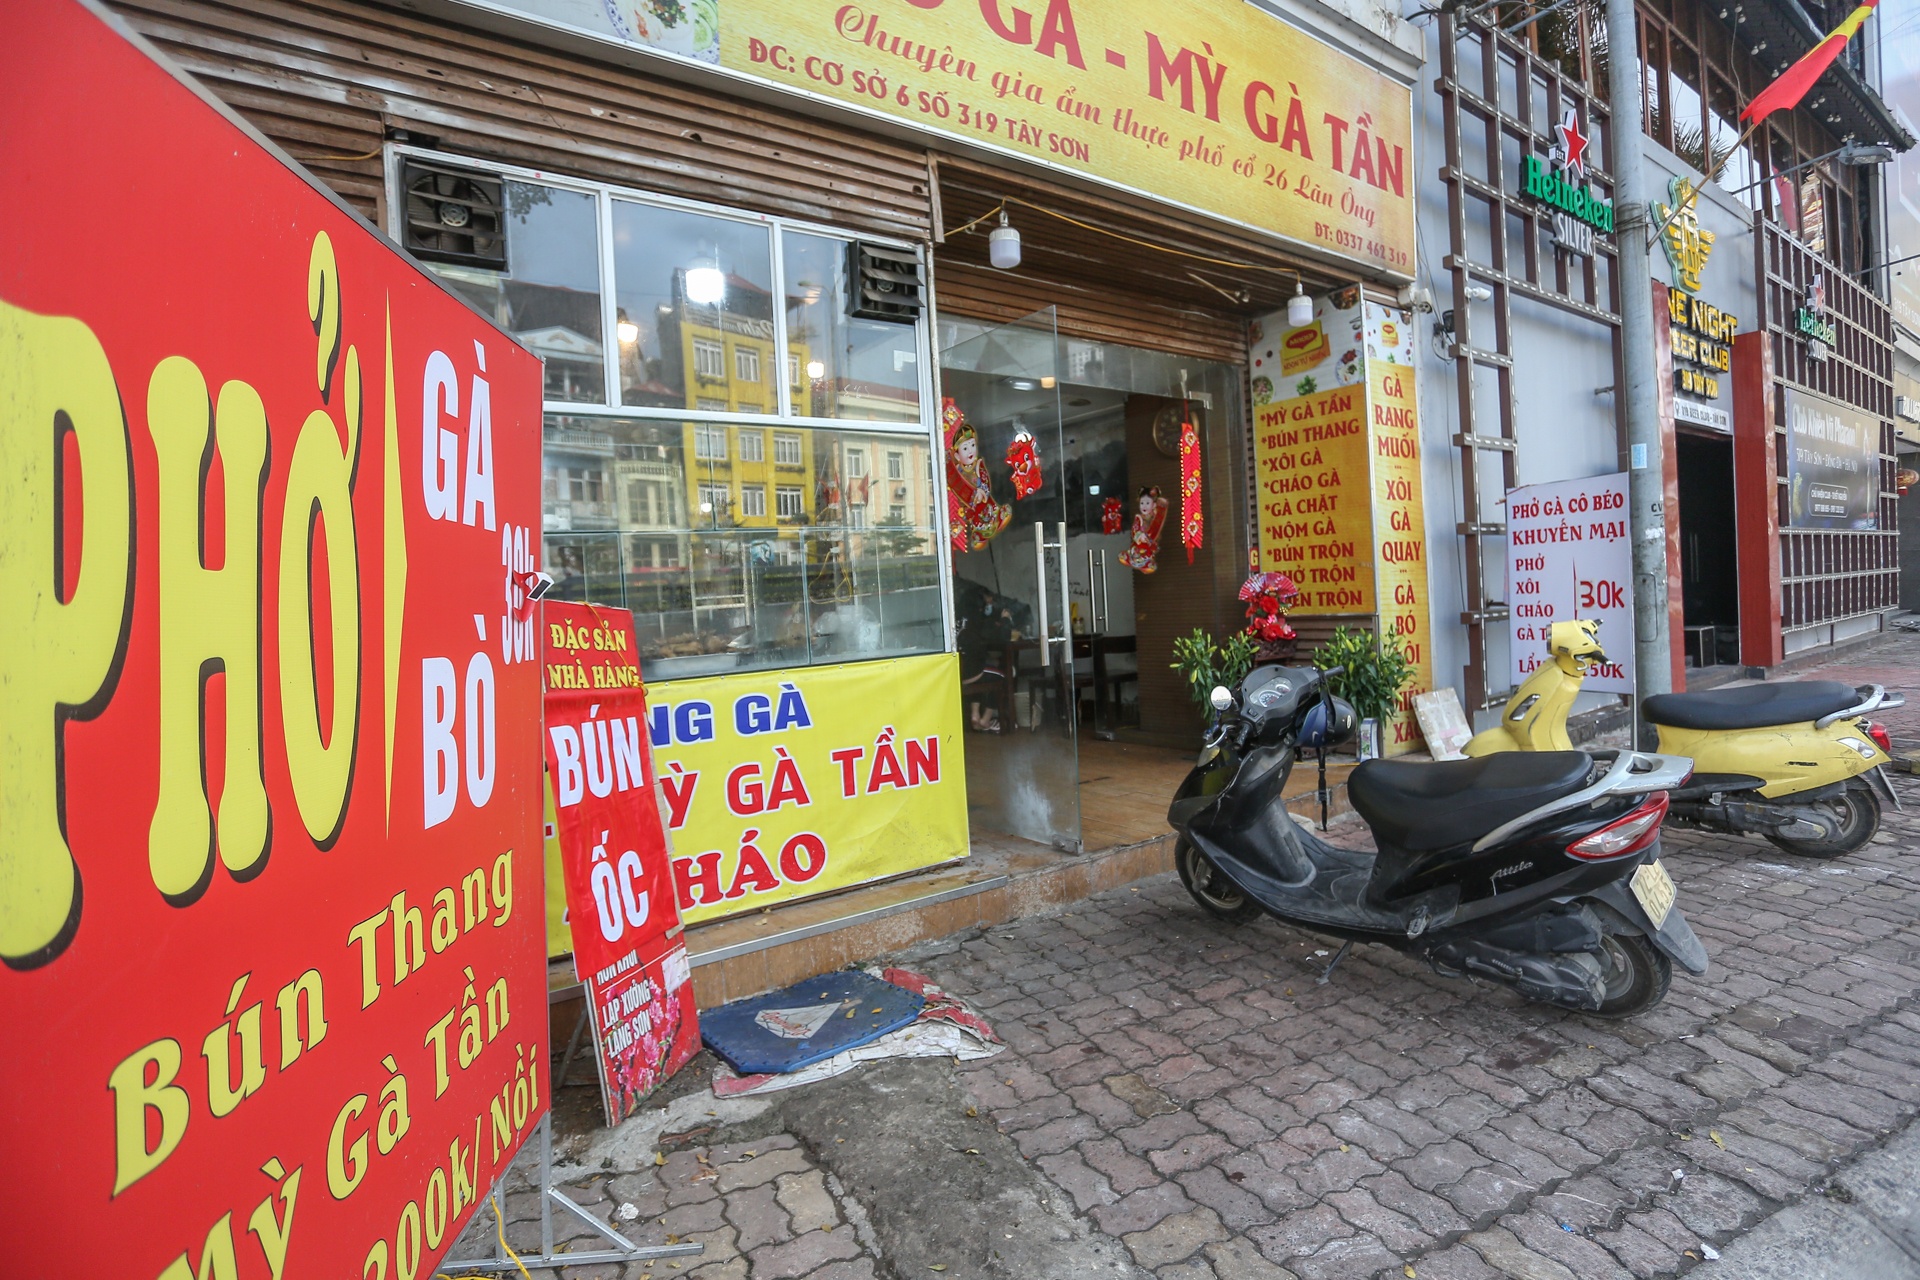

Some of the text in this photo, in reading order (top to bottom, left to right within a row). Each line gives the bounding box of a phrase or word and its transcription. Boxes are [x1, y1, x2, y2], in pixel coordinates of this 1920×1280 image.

[747, 36, 1090, 163] ĐC: CƠ SỞ 6 SỐ 319 TÂY SƠN
[834, 5, 979, 82] Chuyên
[991, 71, 1045, 105] gia
[1056, 86, 1103, 125] ẩm
[1112, 107, 1170, 149] thực
[1178, 135, 1227, 167] phố
[1232, 154, 1257, 179] cổ
[1263, 163, 1288, 191] 26
[1340, 187, 1376, 228] Ông
[1144, 30, 1228, 123] MỲ
[1243, 81, 1314, 161] GÀ
[1323, 110, 1405, 199] TẦN
[1525, 154, 1614, 233] Heineken
[1314, 221, 1333, 242] ĐT:
[1336, 228, 1364, 251] 0337
[1389, 247, 1408, 266] 319
[1557, 212, 1593, 256] SILVER
[1691, 298, 1738, 346] NIGHT
[1699, 341, 1729, 372] CLUB
[1382, 373, 1404, 398] GÀ
[1292, 401, 1314, 421] GÀ
[1319, 394, 1352, 416] TẦN
[1375, 404, 1415, 429] RANG
[421, 339, 497, 532] GÀ
[1302, 418, 1360, 443] THANG
[1300, 447, 1323, 467] GÀ
[1377, 432, 1416, 459] MUỐI
[1317, 468, 1341, 487] GÀ
[1385, 476, 1412, 501] XÔI
[1296, 494, 1338, 516] CHẶT
[1512, 489, 1624, 519] PHỞ GÀ CÔ BÉO
[1313, 516, 1336, 535] GÀ
[1390, 506, 1412, 531] GÀ
[1512, 518, 1626, 545] KHUYẾN MẠI
[1310, 541, 1354, 561] TRỘN
[1382, 541, 1421, 564] QUAY
[1515, 553, 1545, 571] PHỞ
[1310, 564, 1355, 585] TRỘN
[1515, 578, 1540, 594] XÔI
[0, 230, 363, 970] PHỞ
[1316, 589, 1363, 608] TRỘN
[1394, 580, 1415, 605] GÀ
[1516, 601, 1554, 617] CHÁO
[549, 618, 627, 656] ĐẶC SẢN
[1395, 613, 1417, 635] BÓ
[1517, 624, 1535, 640] GÀ
[547, 658, 640, 690] NHÀ HÀNG
[421, 614, 497, 829] BÒ
[734, 683, 814, 736] GÀ
[548, 703, 645, 809] BÚN
[726, 746, 812, 816] GÀ
[831, 726, 942, 798] TẦN
[590, 829, 650, 943] ỐC
[346, 849, 514, 1012] Thang
[107, 971, 328, 1201] Bún
[326, 1054, 412, 1200] Gà
[424, 966, 511, 1102] Tần
